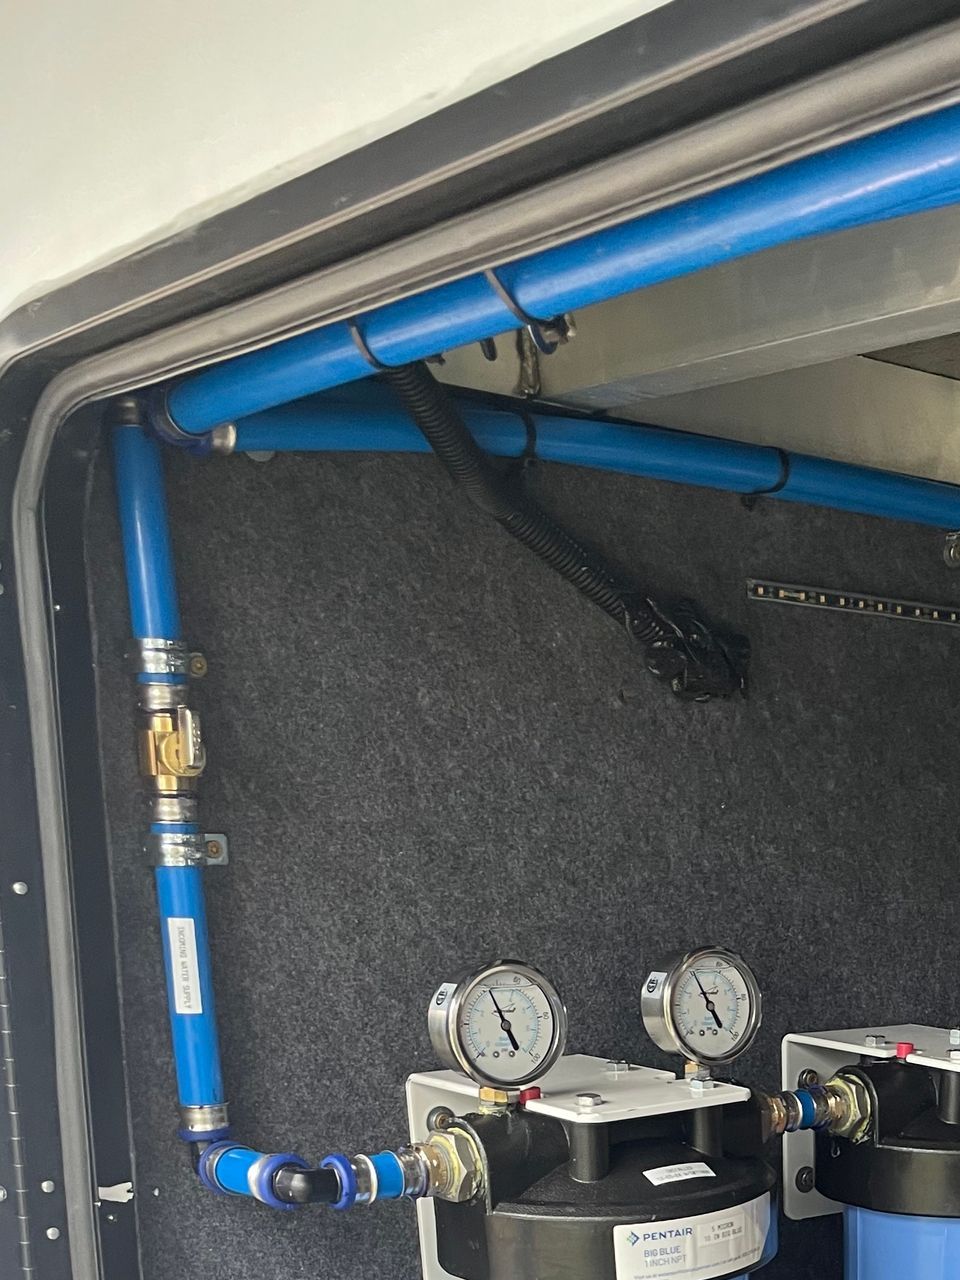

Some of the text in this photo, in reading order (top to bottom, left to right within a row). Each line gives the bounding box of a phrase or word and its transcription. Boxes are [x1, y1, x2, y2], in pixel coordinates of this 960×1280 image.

[180, 960, 190, 982] WATER
[182, 985, 192, 1009] SUPPLY
[643, 1227, 693, 1241] PENTAIR
[644, 1246, 681, 1258] BIG BLUE
[650, 1257, 671, 1267] INCH
[671, 1255, 687, 1266] NPT
